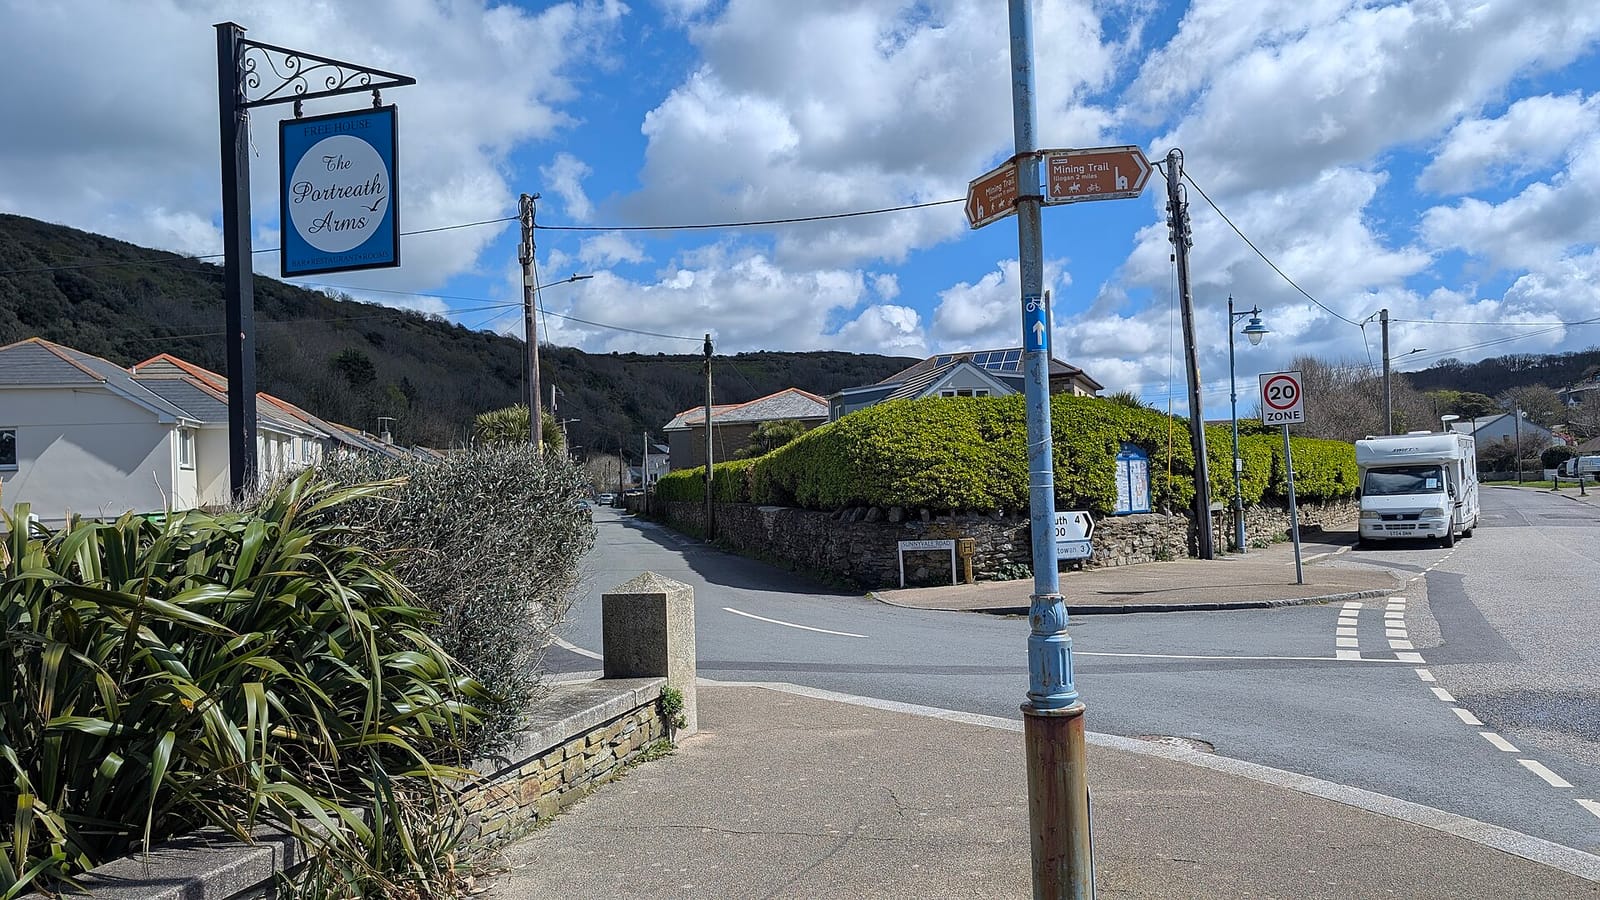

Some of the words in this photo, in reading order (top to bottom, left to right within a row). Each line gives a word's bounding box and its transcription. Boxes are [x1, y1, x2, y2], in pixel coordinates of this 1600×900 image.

[304, 123, 332, 137] FREE
[334, 118, 372, 133] HOUSE
[322, 154, 352, 172] The
[1053, 164, 1085, 174] Mining
[1088, 162, 1110, 172] Trail
[293, 173, 384, 203] Portreath
[985, 183, 1002, 197] Mining
[1003, 176, 1016, 188] Trail
[308, 210, 369, 234] Arms
[1270, 385, 1295, 400] 20
[1267, 410, 1301, 421] ZONE
[1074, 515, 1080, 524] 4
[963, 541, 972, 553] H
[1080, 545, 1085, 553] 3
